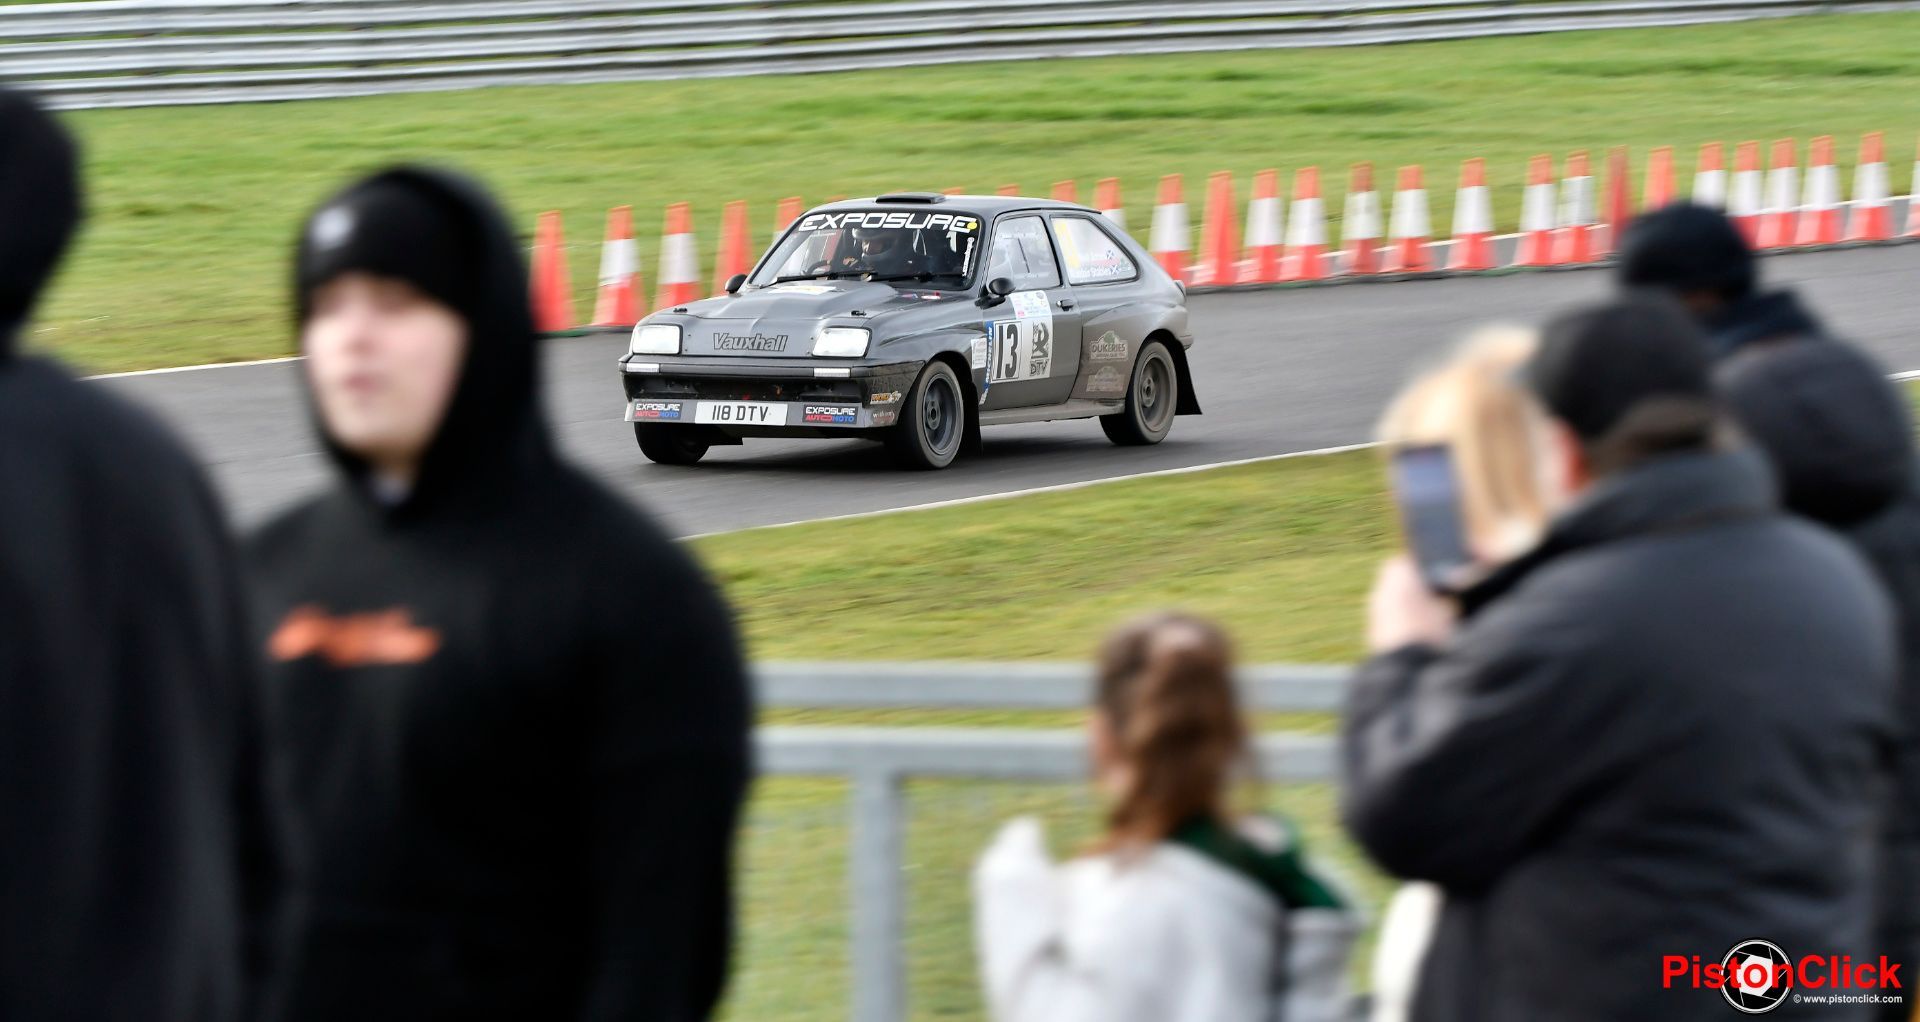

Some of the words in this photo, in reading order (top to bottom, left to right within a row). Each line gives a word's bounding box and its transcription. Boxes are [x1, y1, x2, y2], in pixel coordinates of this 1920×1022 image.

[798, 212, 977, 234] EXPOSURE
[713, 332, 789, 352] Vauxhall
[1091, 343, 1126, 353] DUKERIES
[996, 323, 1019, 379] 13
[1029, 360, 1049, 376] DTV
[634, 403, 681, 412] EXPOSURE
[711, 405, 731, 421] 118
[735, 406, 770, 422] DTV
[805, 406, 856, 416] EXPOSURE
